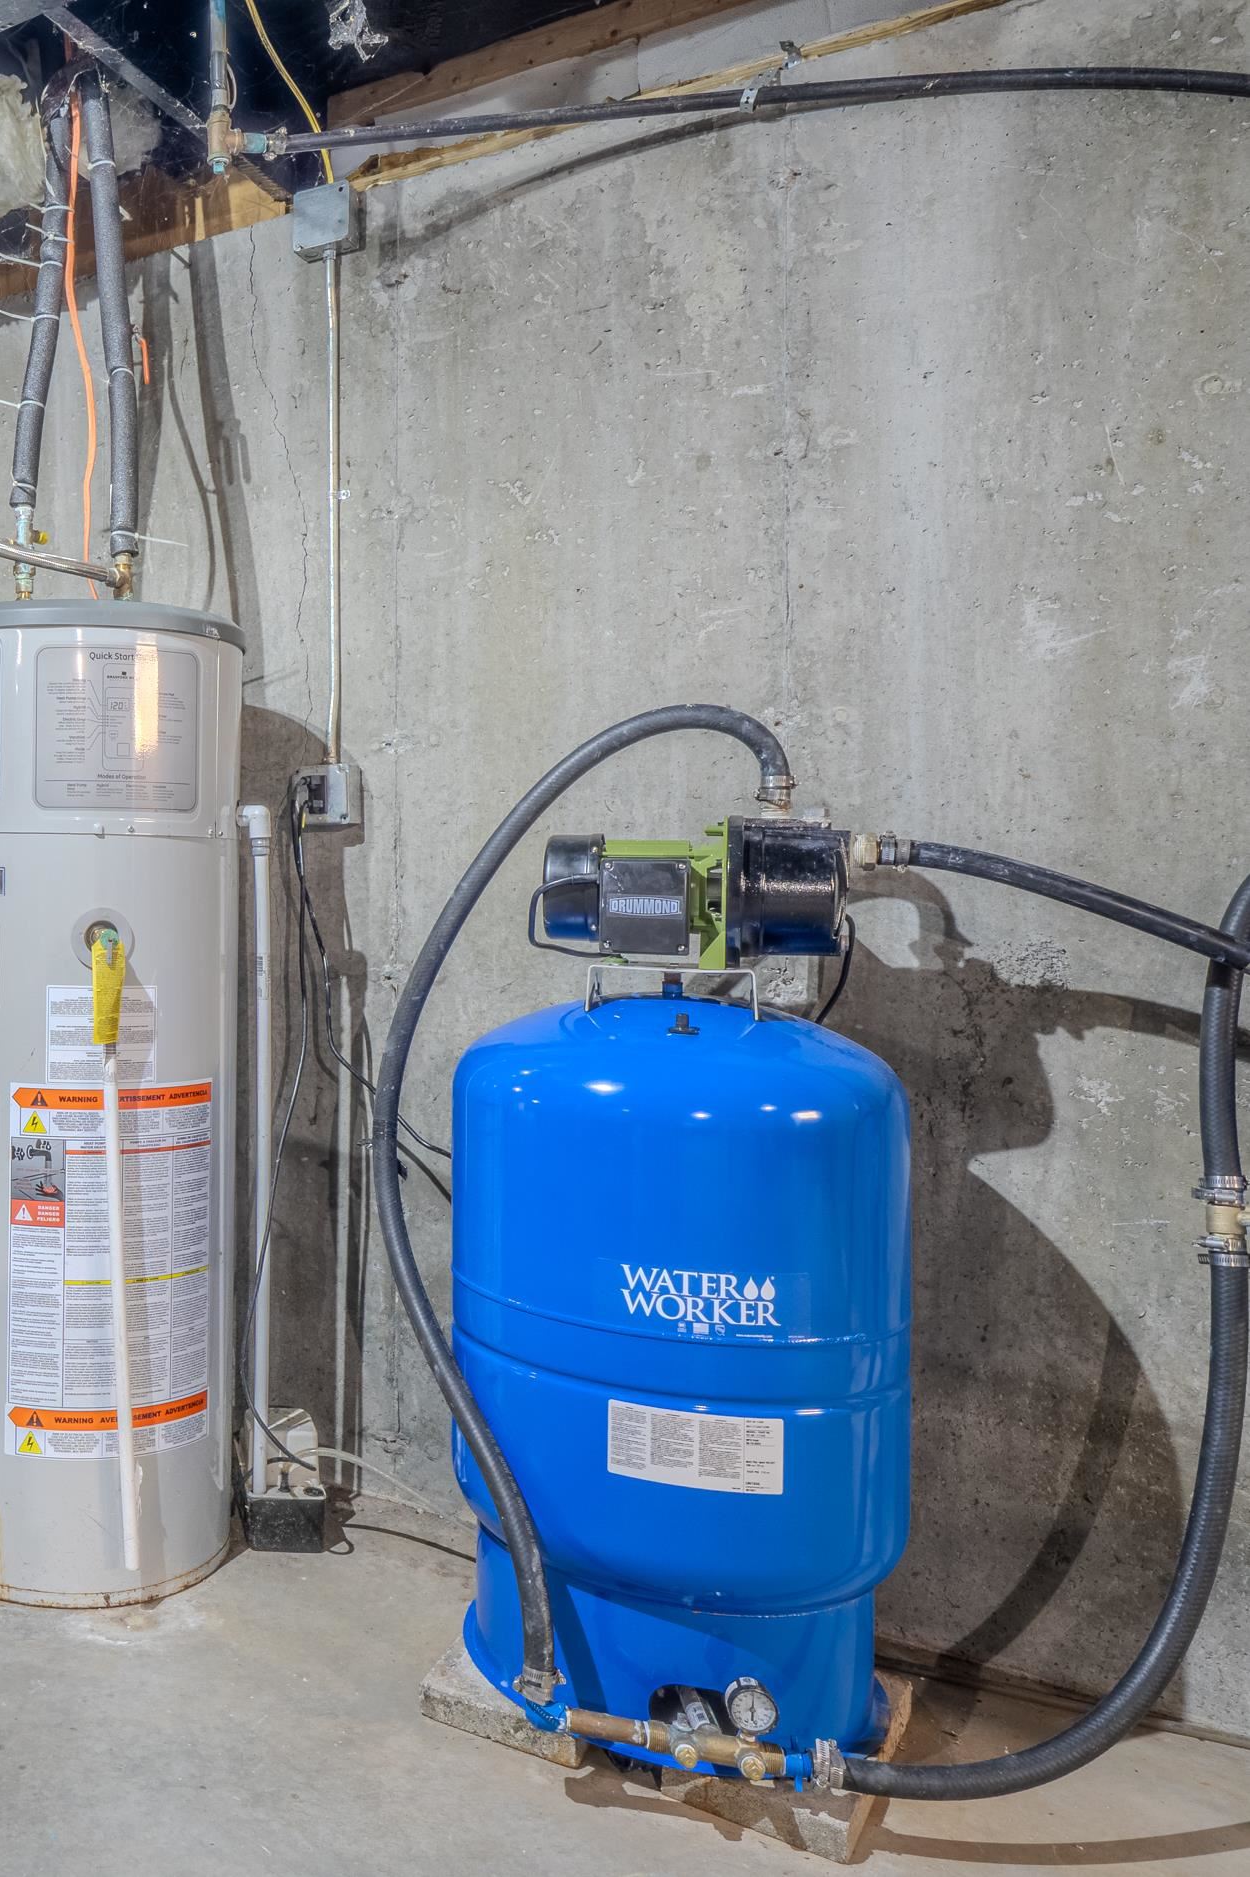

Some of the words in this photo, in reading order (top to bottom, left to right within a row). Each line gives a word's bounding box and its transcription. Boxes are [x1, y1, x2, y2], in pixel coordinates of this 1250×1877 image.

[89, 651, 113, 661] Quick
[611, 898, 679, 915] DRUMMOND
[58, 1095, 99, 1103] WARNING
[620, 1263, 745, 1300] WATER
[620, 1288, 782, 1327] WORKER
[54, 1416, 94, 1424] WARNING
